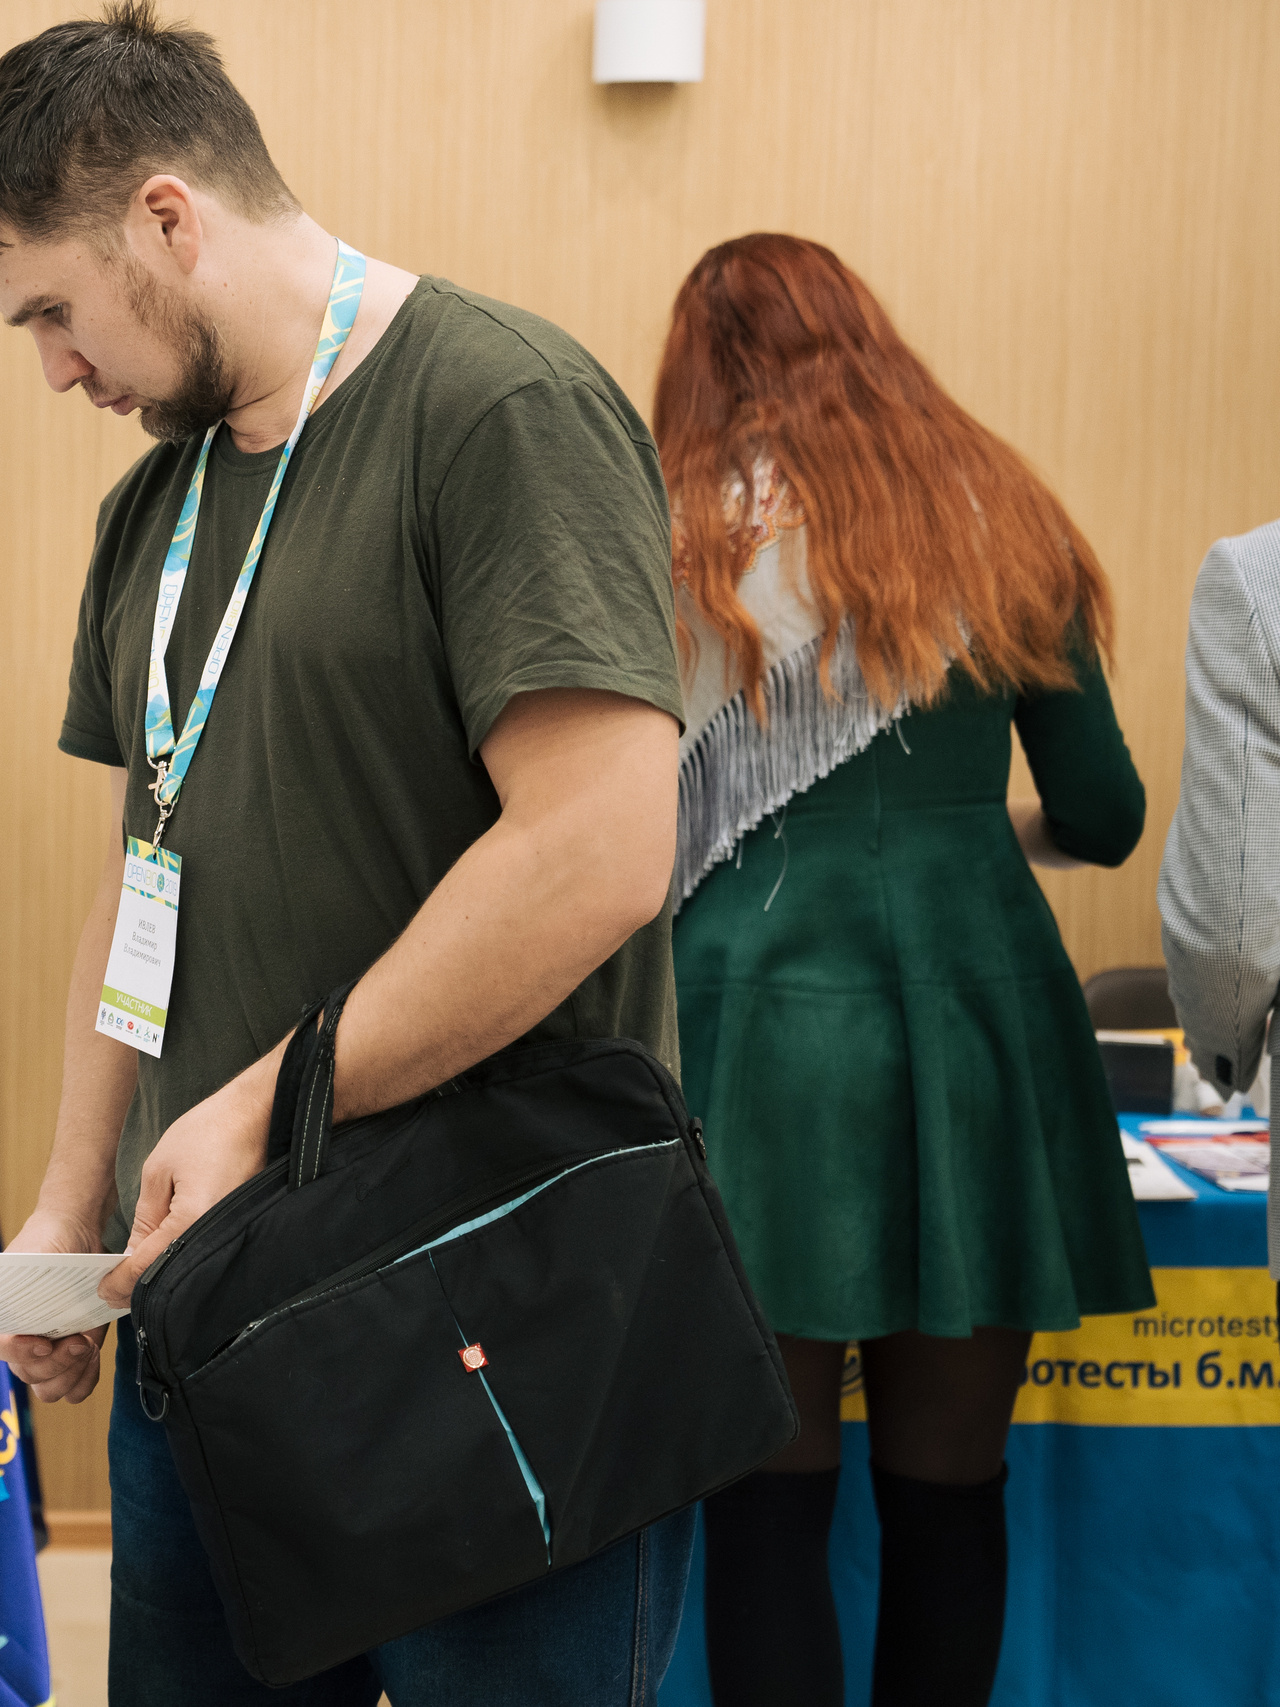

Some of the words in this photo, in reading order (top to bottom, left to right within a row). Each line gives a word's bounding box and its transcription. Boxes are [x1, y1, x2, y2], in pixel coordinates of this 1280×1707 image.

[207, 600, 242, 675] OPENBIO
[115, 992, 154, 1017] УЧАСТНИК
[1019, 1358, 1182, 1389] отесты
